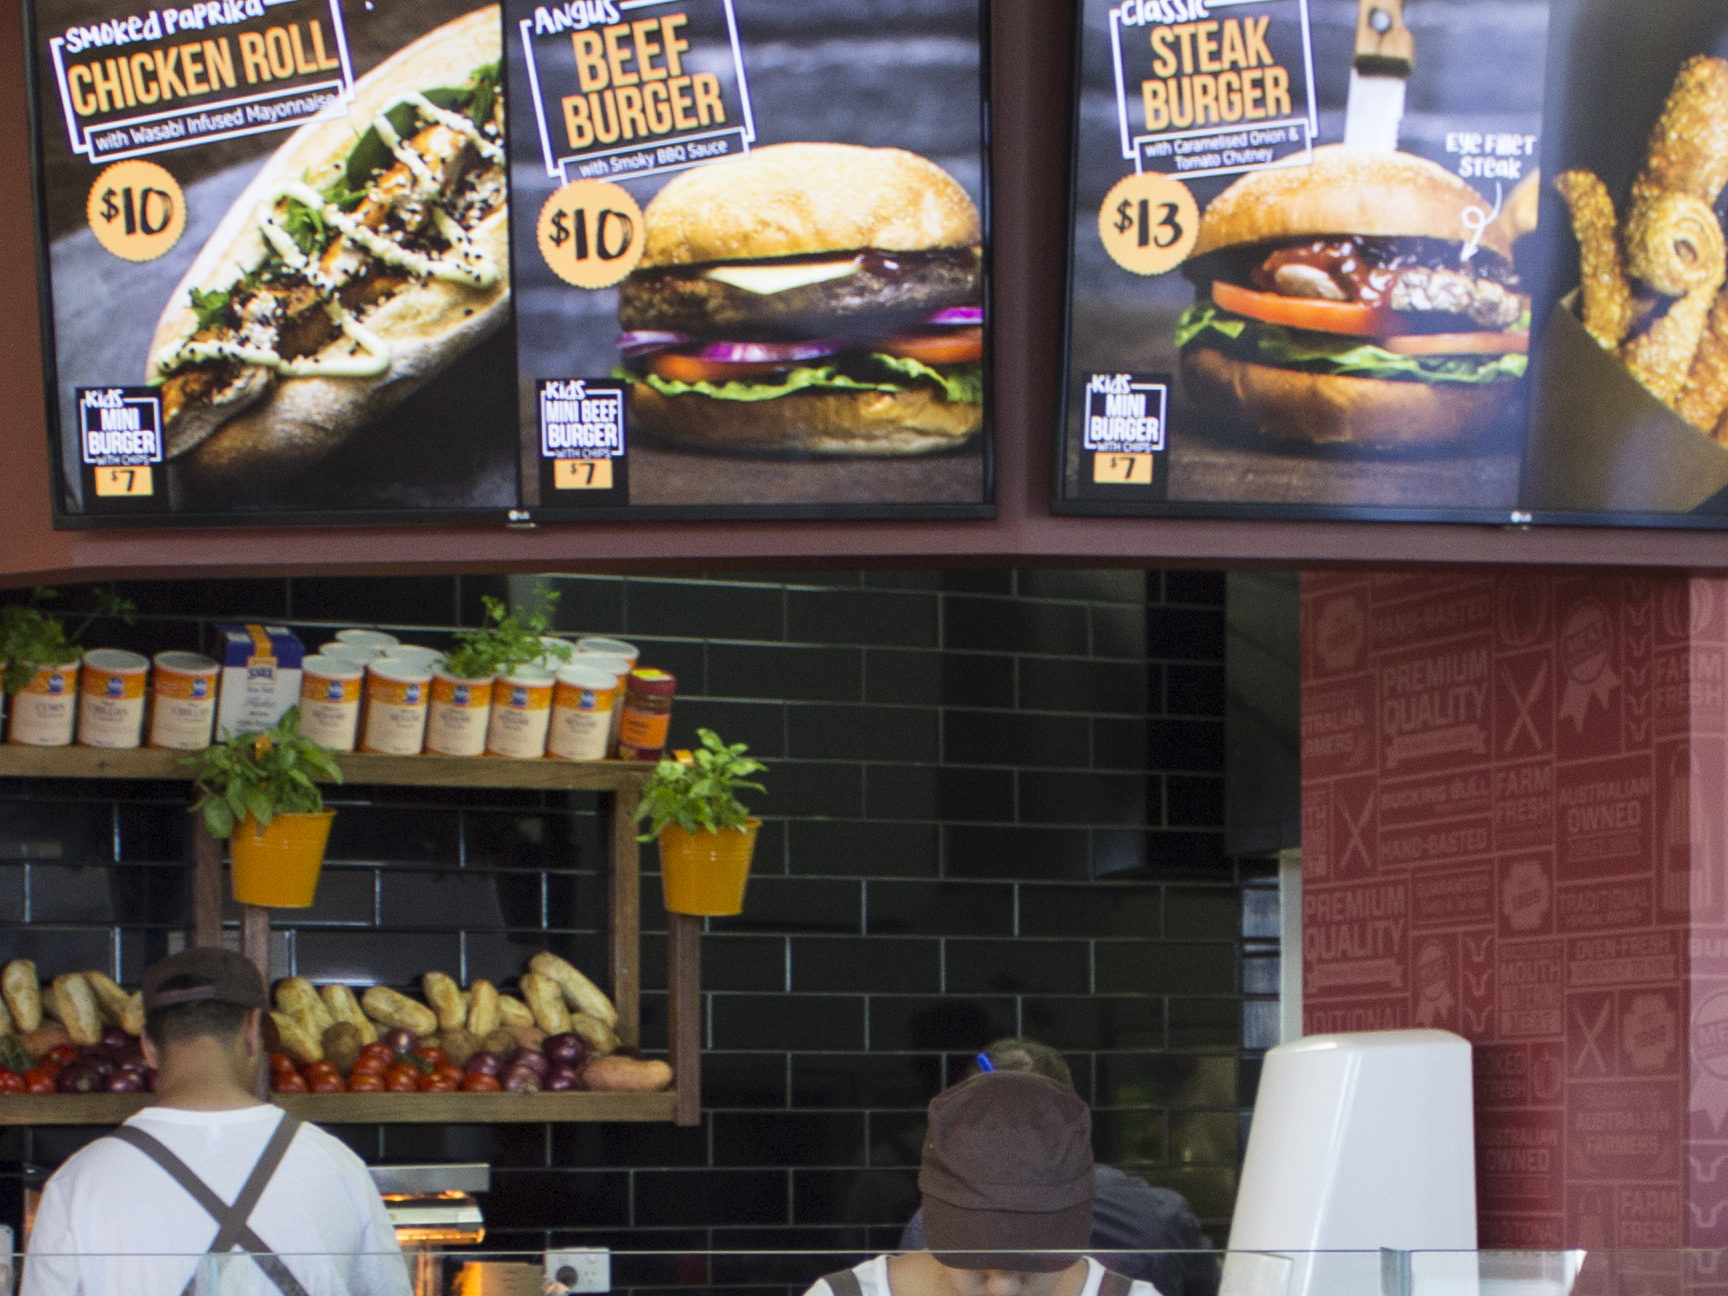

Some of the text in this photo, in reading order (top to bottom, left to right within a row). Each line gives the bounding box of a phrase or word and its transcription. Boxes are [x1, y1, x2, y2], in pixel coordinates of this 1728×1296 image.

[572, 12, 689, 93] BEEF
[1151, 14, 1274, 78] STEAK
[67, 19, 339, 117] CHICKEN ROLL
[561, 72, 726, 150] BURGER
[1142, 65, 1292, 132] BURGER
[96, 131, 129, 152] with
[130, 118, 184, 145] Wasabi
[188, 111, 244, 135] Infused
[1145, 126, 1300, 158] with Caramelised Onion &
[579, 140, 729, 177] with Smoky BBQ Sauce
[1175, 147, 1273, 170] Tomato Chutney
[100, 186, 172, 237] $10
[1113, 198, 1183, 249] $13
[548, 207, 634, 262] $10
[100, 407, 141, 431] MINI
[546, 399, 618, 423] MINI BEEF
[1106, 393, 1146, 418] MINI
[87, 429, 156, 455] BURGER
[547, 422, 618, 448] BURGER
[1090, 416, 1159, 442] BURGER
[112, 469, 135, 492] $7
[570, 462, 595, 485] $7
[1110, 457, 1136, 480] $7
[1384, 647, 1488, 697] PREMIUM
[1385, 681, 1489, 734] QUALITY
